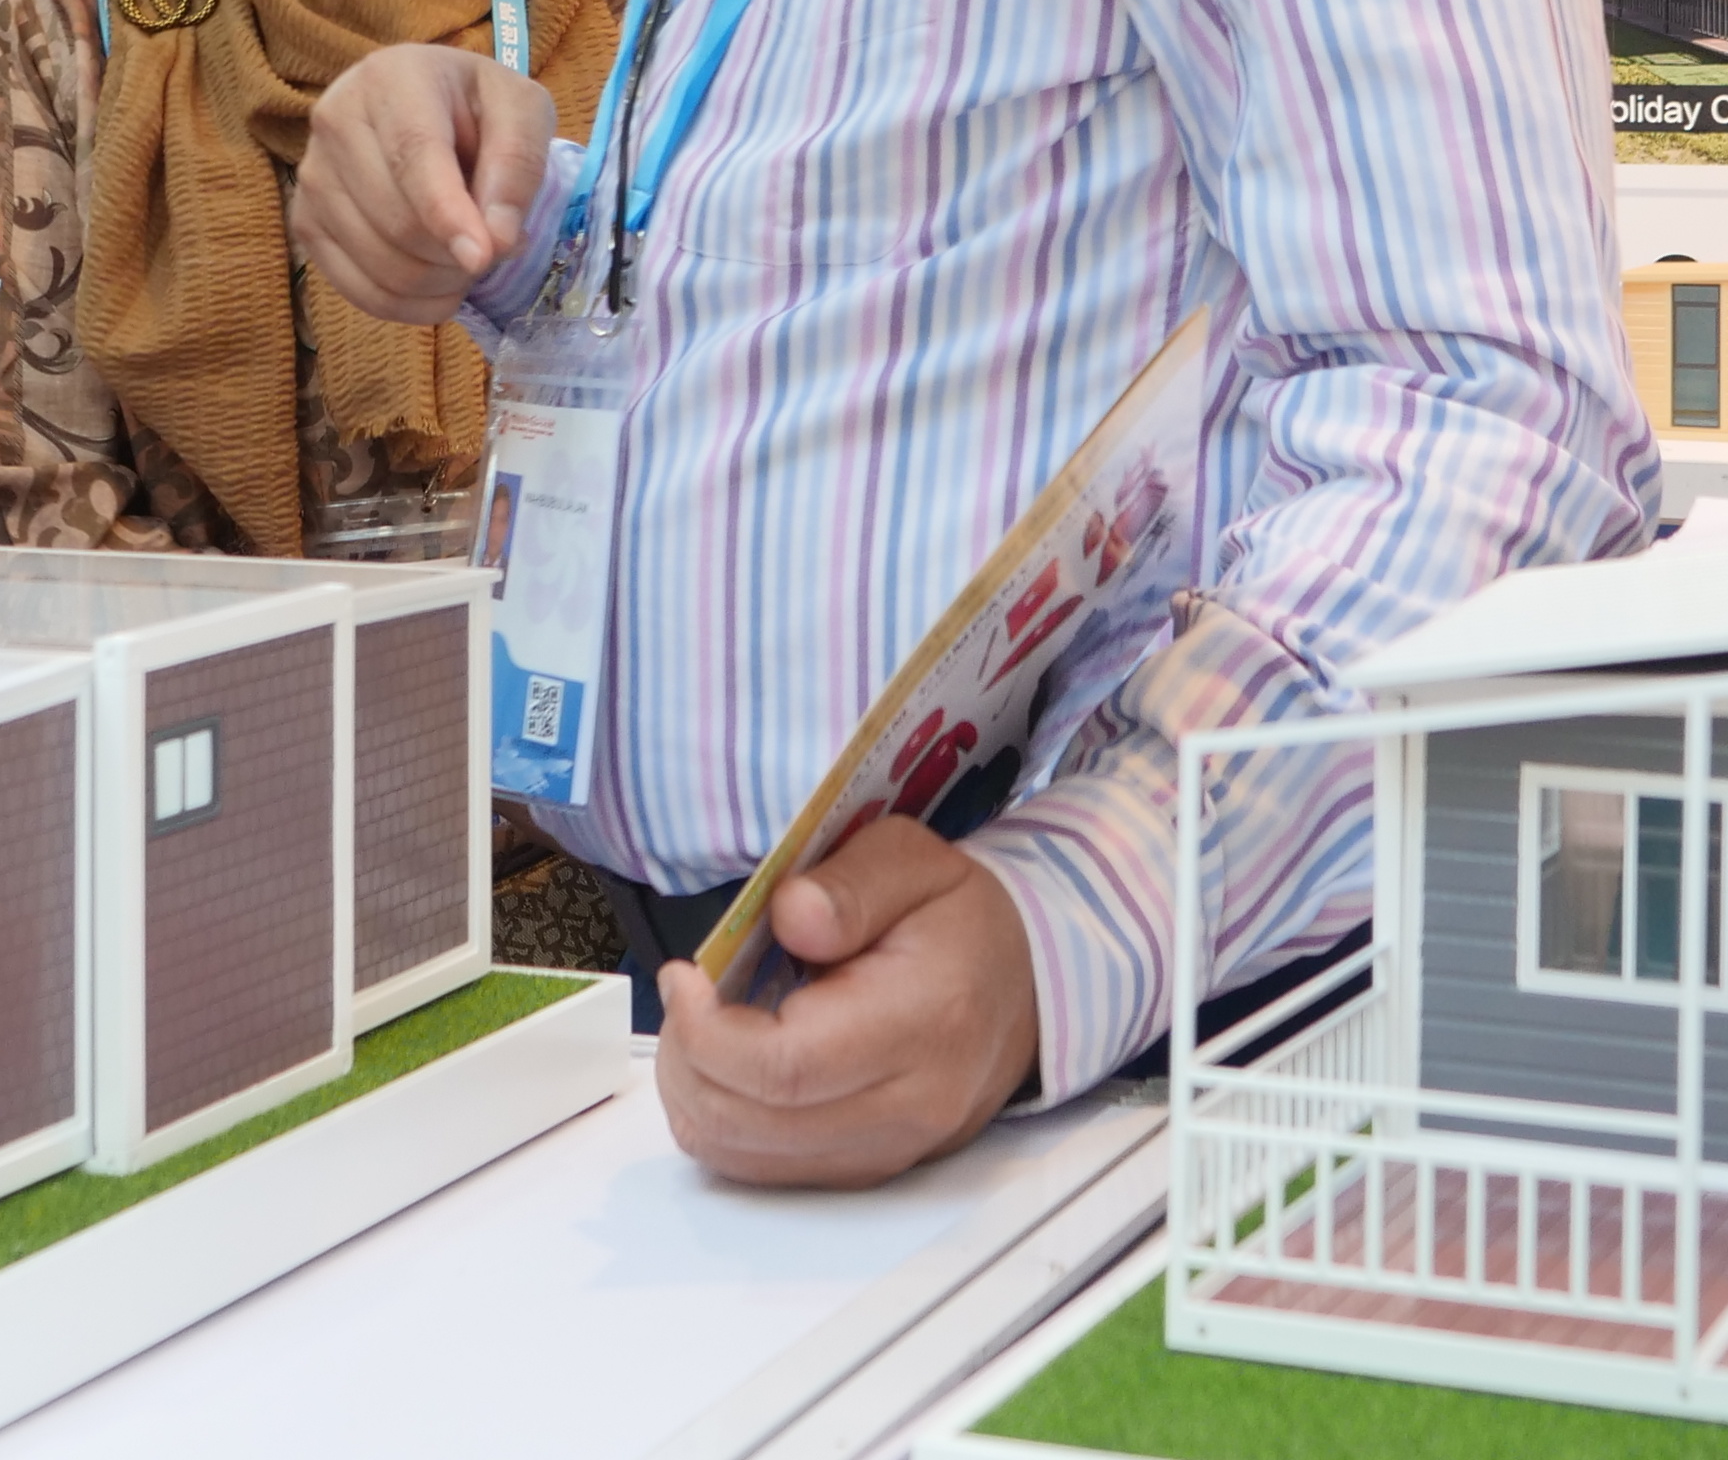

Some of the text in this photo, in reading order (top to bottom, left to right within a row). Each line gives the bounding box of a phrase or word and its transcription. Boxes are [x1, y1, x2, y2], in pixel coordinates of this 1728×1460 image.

[499, 2, 519, 70] 交世界
[1610, 94, 1702, 130] oliday
